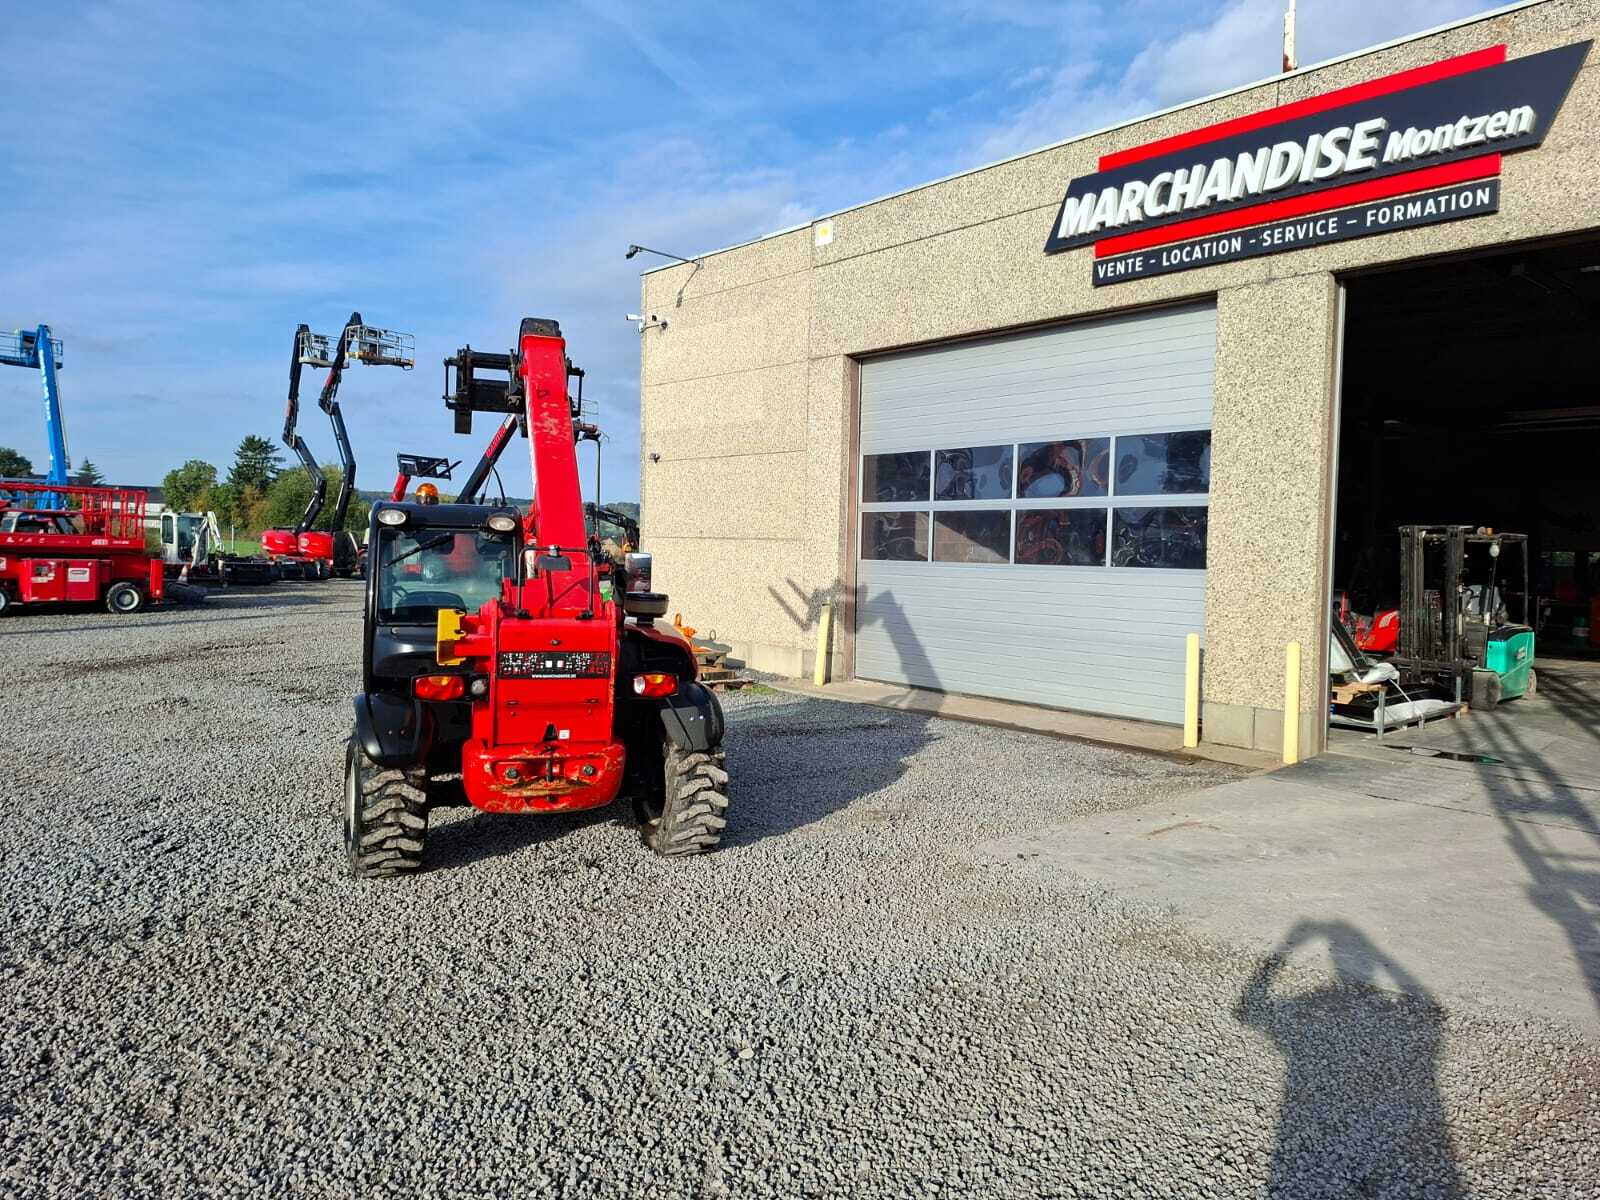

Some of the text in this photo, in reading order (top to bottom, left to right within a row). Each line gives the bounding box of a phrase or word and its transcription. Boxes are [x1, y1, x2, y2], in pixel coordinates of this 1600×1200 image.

[1057, 105, 1536, 239] MARCHANDISE Montzen
[1098, 256, 1143, 279] VENTE
[1162, 236, 1242, 267] LOCATION
[1262, 217, 1338, 247] SERVICE
[1366, 187, 1491, 227] FORMATION
